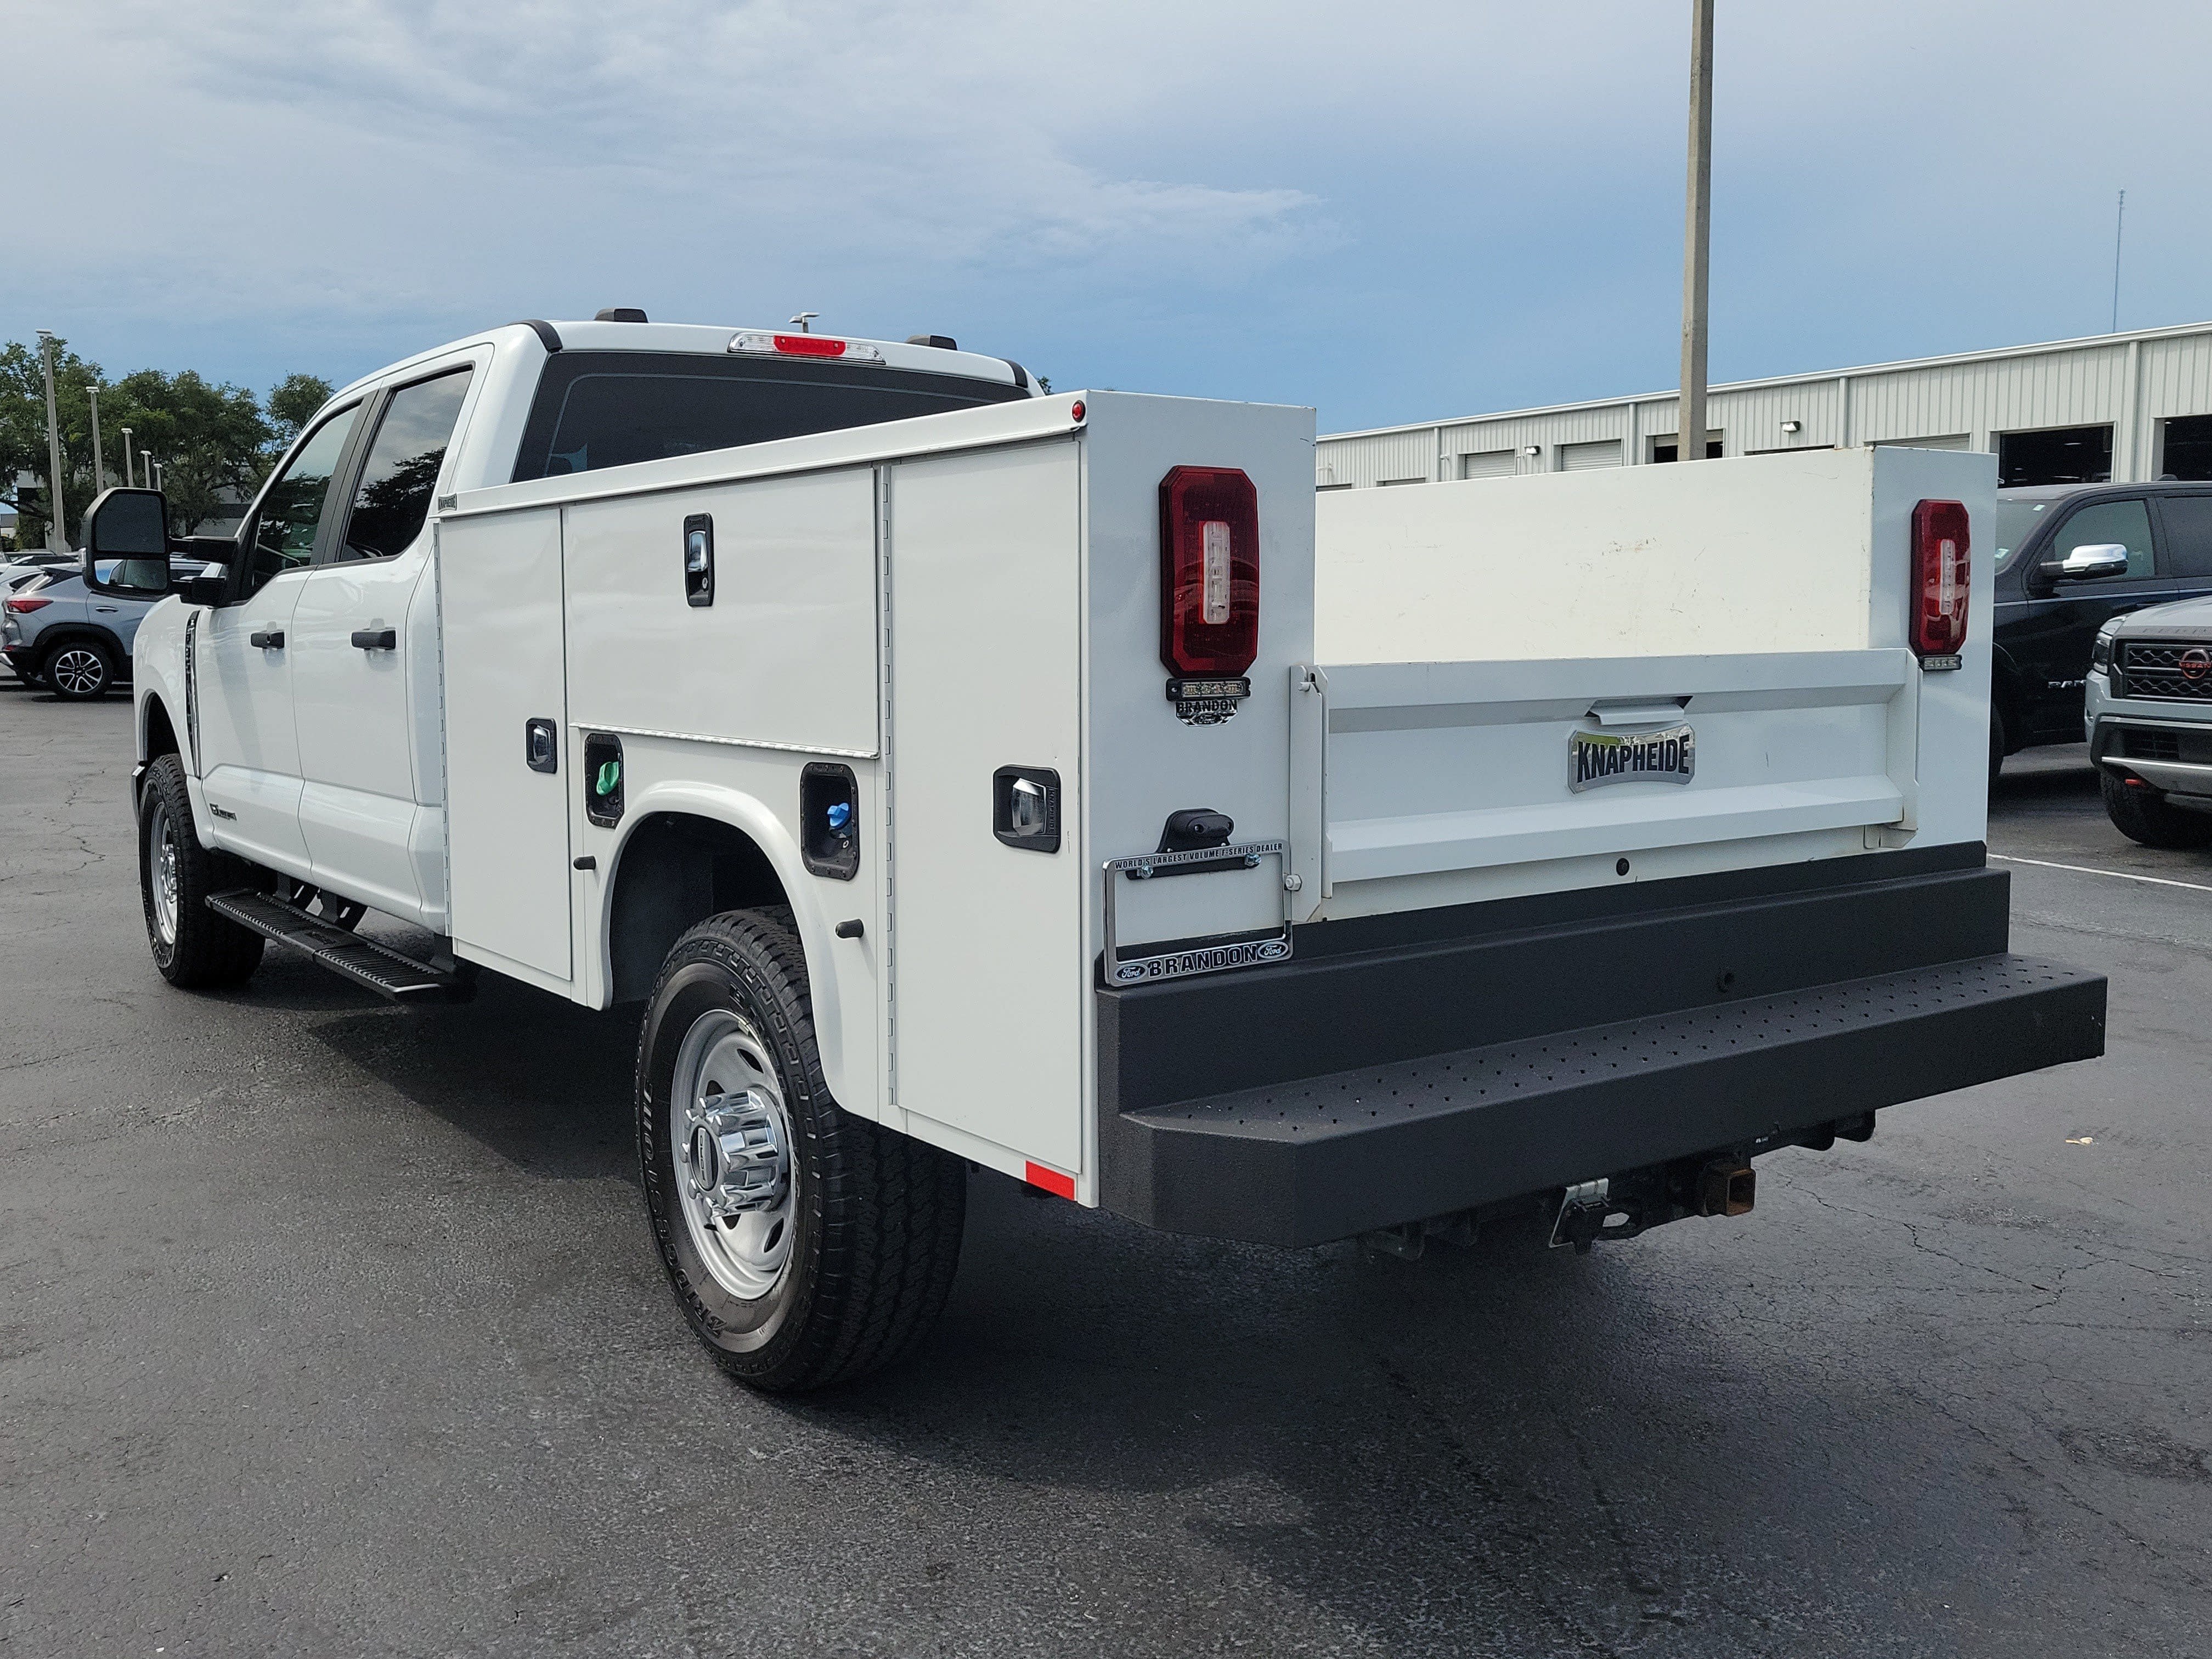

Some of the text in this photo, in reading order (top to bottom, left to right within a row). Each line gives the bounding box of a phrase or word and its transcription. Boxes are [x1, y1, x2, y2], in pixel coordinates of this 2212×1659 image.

[439, 495, 456, 510] KNAPHEIDE
[1179, 699, 1237, 713] BRANDON
[1577, 734, 1690, 783] KNAPHEIDE
[1115, 843, 1283, 870] WORLD'S LARGEST VOLUME F-SERIES DEALER
[1121, 945, 1282, 978] Ford BRANDON Ford
